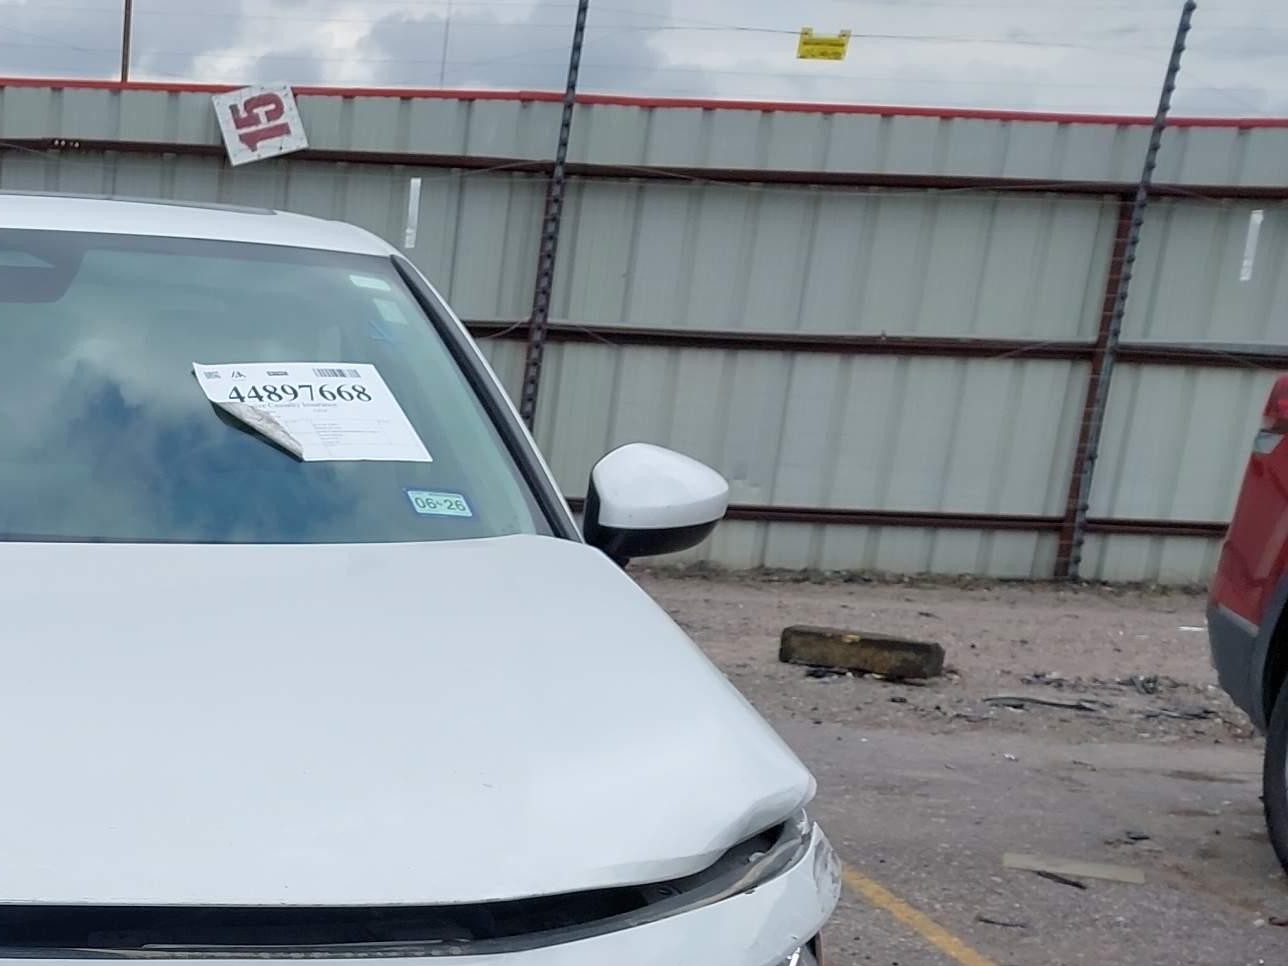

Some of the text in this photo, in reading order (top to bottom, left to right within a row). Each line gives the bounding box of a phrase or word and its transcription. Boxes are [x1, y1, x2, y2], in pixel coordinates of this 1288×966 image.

[229, 93, 292, 152] 15
[228, 384, 372, 402] 44897668
[414, 497, 466, 511] 06-26
